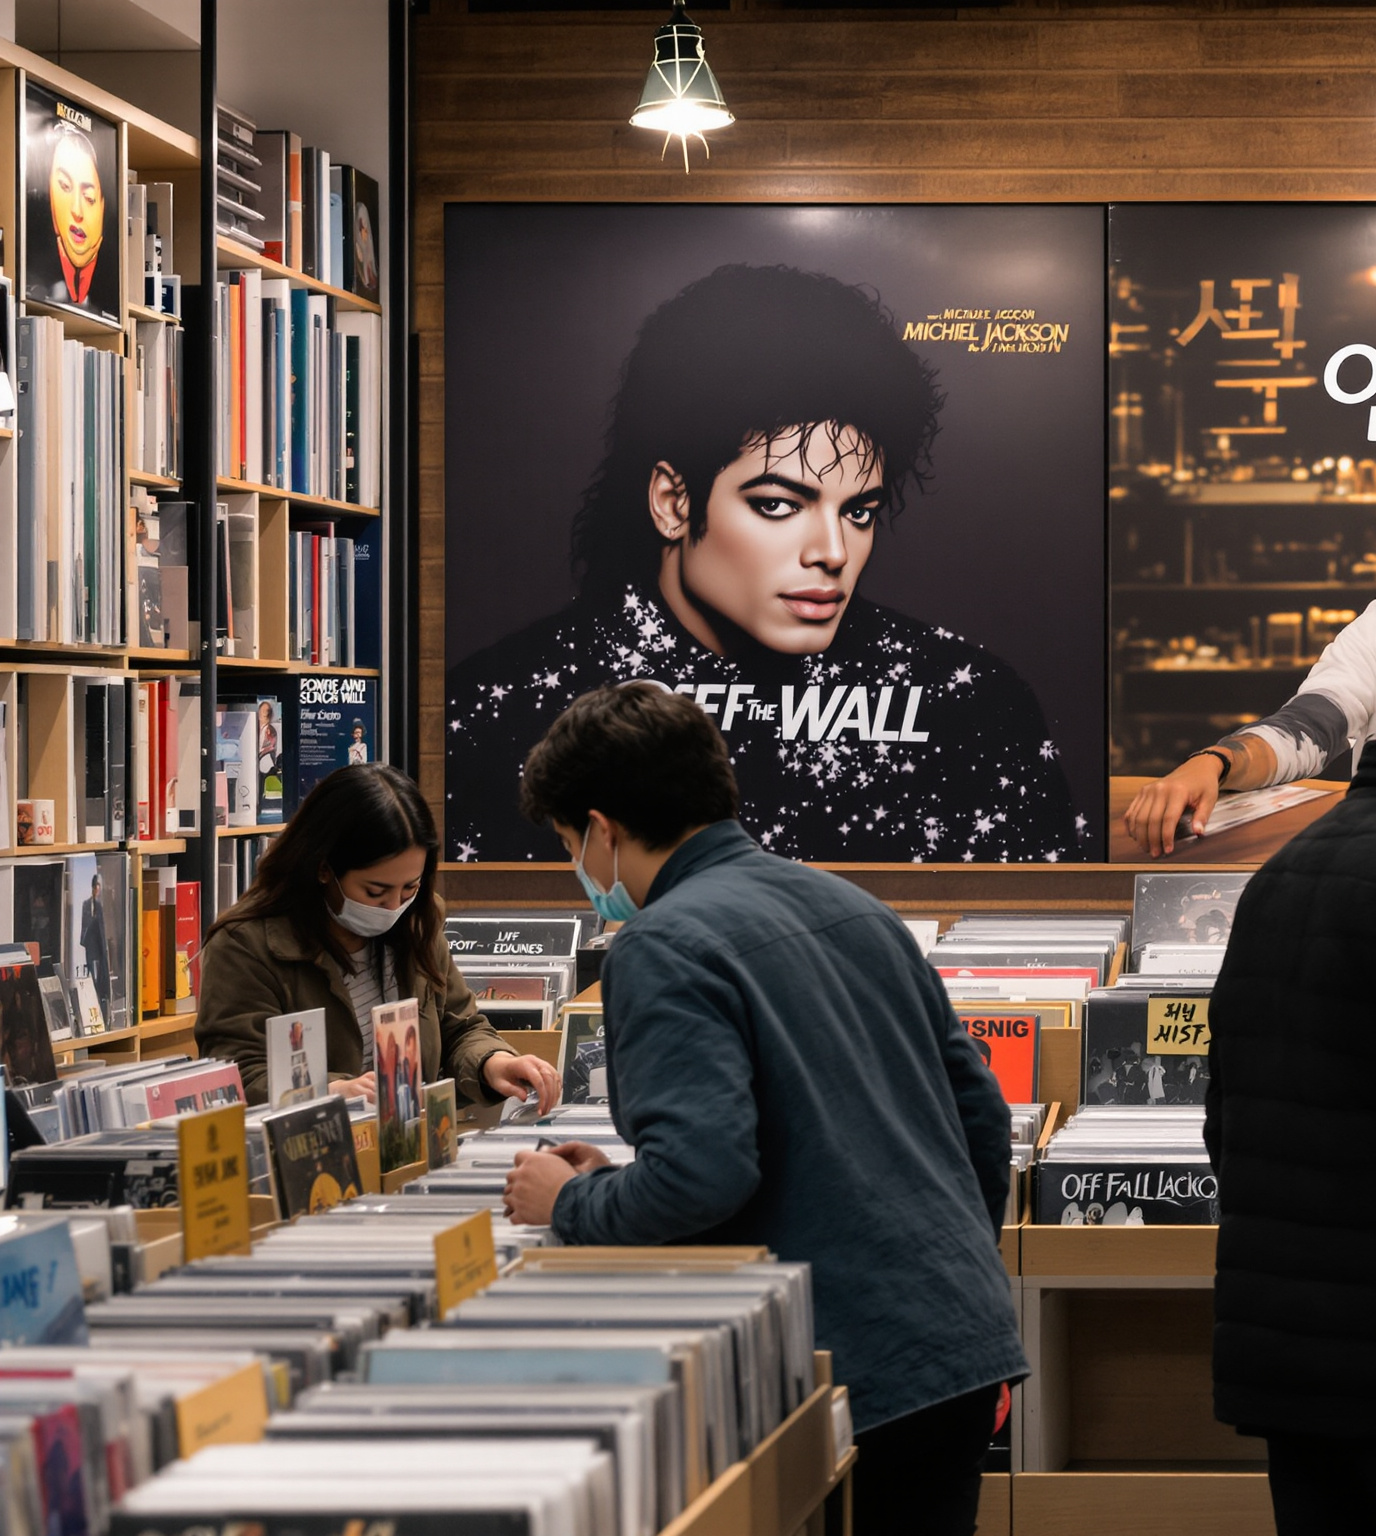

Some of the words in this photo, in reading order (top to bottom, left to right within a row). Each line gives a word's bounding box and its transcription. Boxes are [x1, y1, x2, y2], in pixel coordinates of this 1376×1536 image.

[980, 322, 1070, 351] JACKSON
[747, 699, 778, 721] THE
[781, 684, 930, 742] WALL
[1062, 1173, 1104, 1201] OFF
